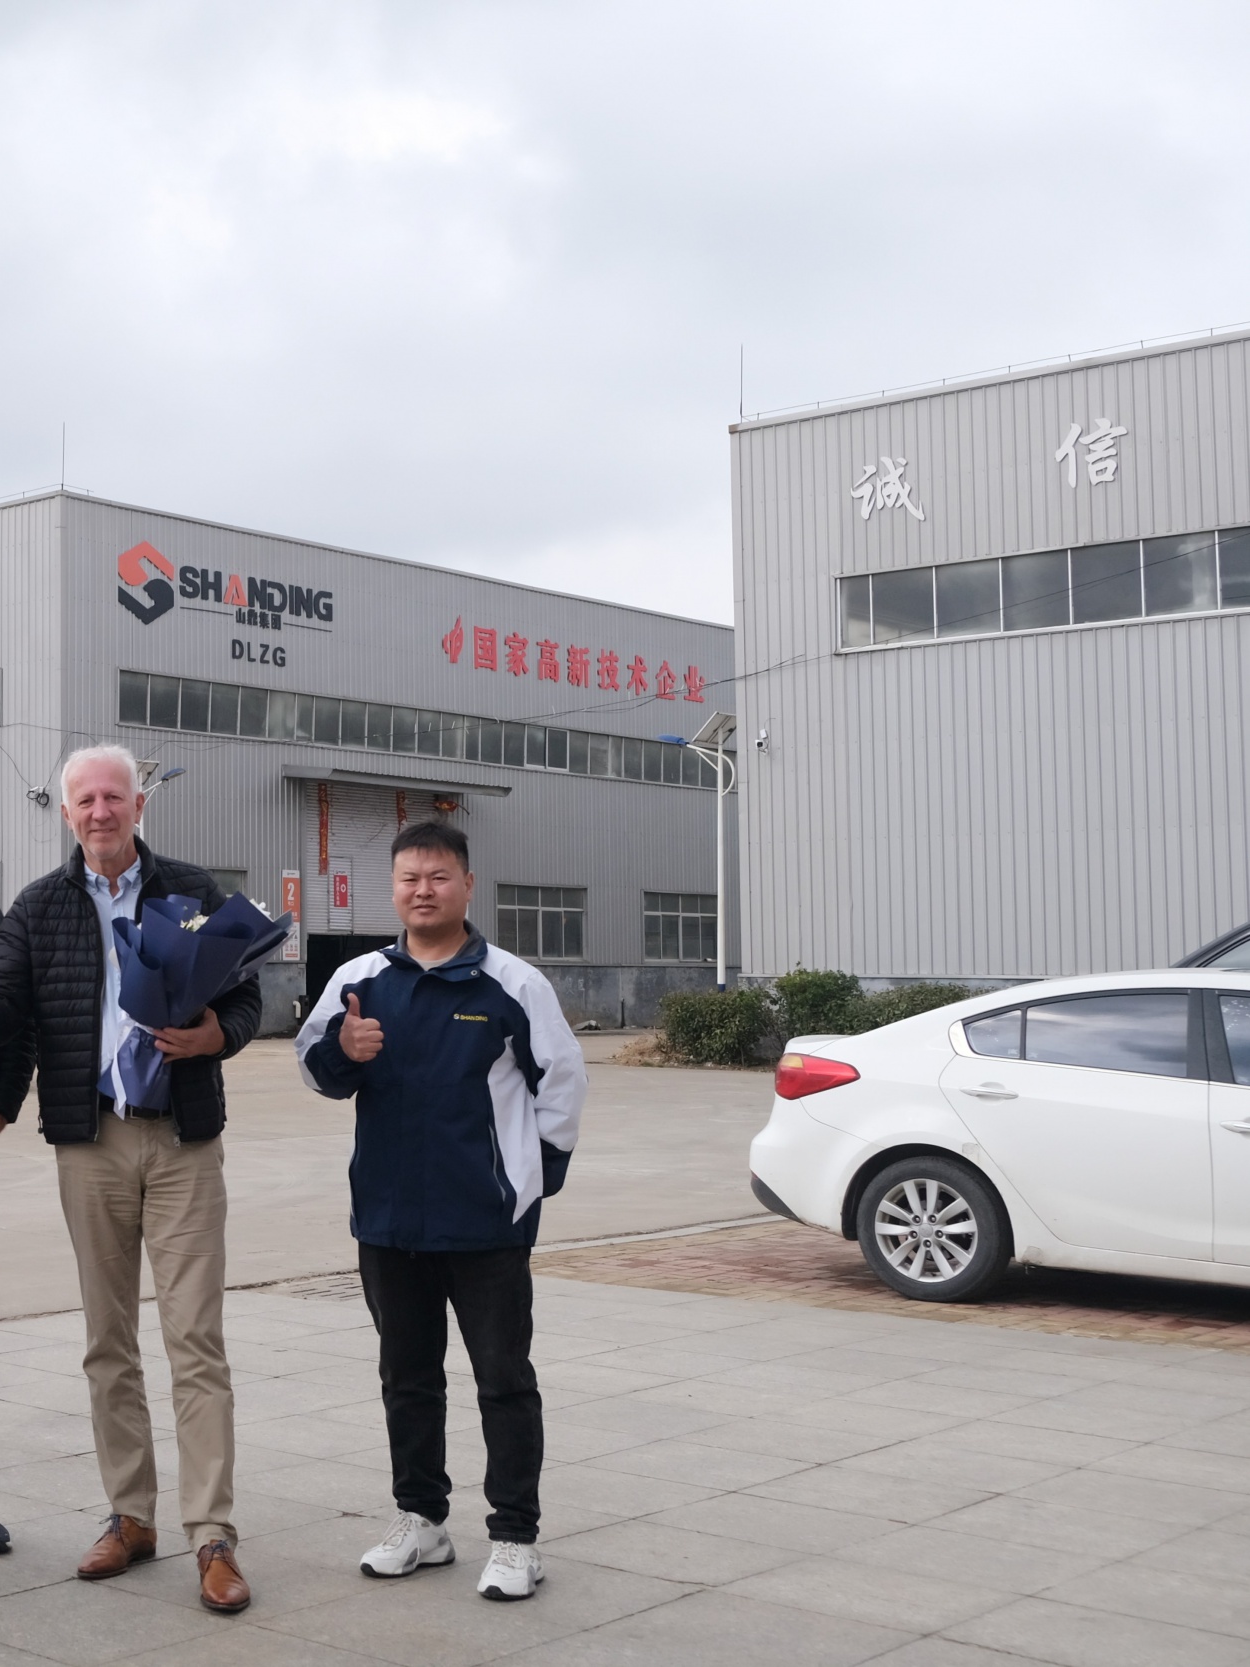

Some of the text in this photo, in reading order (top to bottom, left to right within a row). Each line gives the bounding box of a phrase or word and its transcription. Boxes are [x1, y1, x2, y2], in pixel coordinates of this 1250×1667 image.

[851, 417, 1128, 522] 诚信
[179, 565, 333, 622] SHANDING
[231, 638, 286, 668] DLZG
[473, 625, 706, 704] 国家高新技术企业
[287, 882, 295, 901] 2
